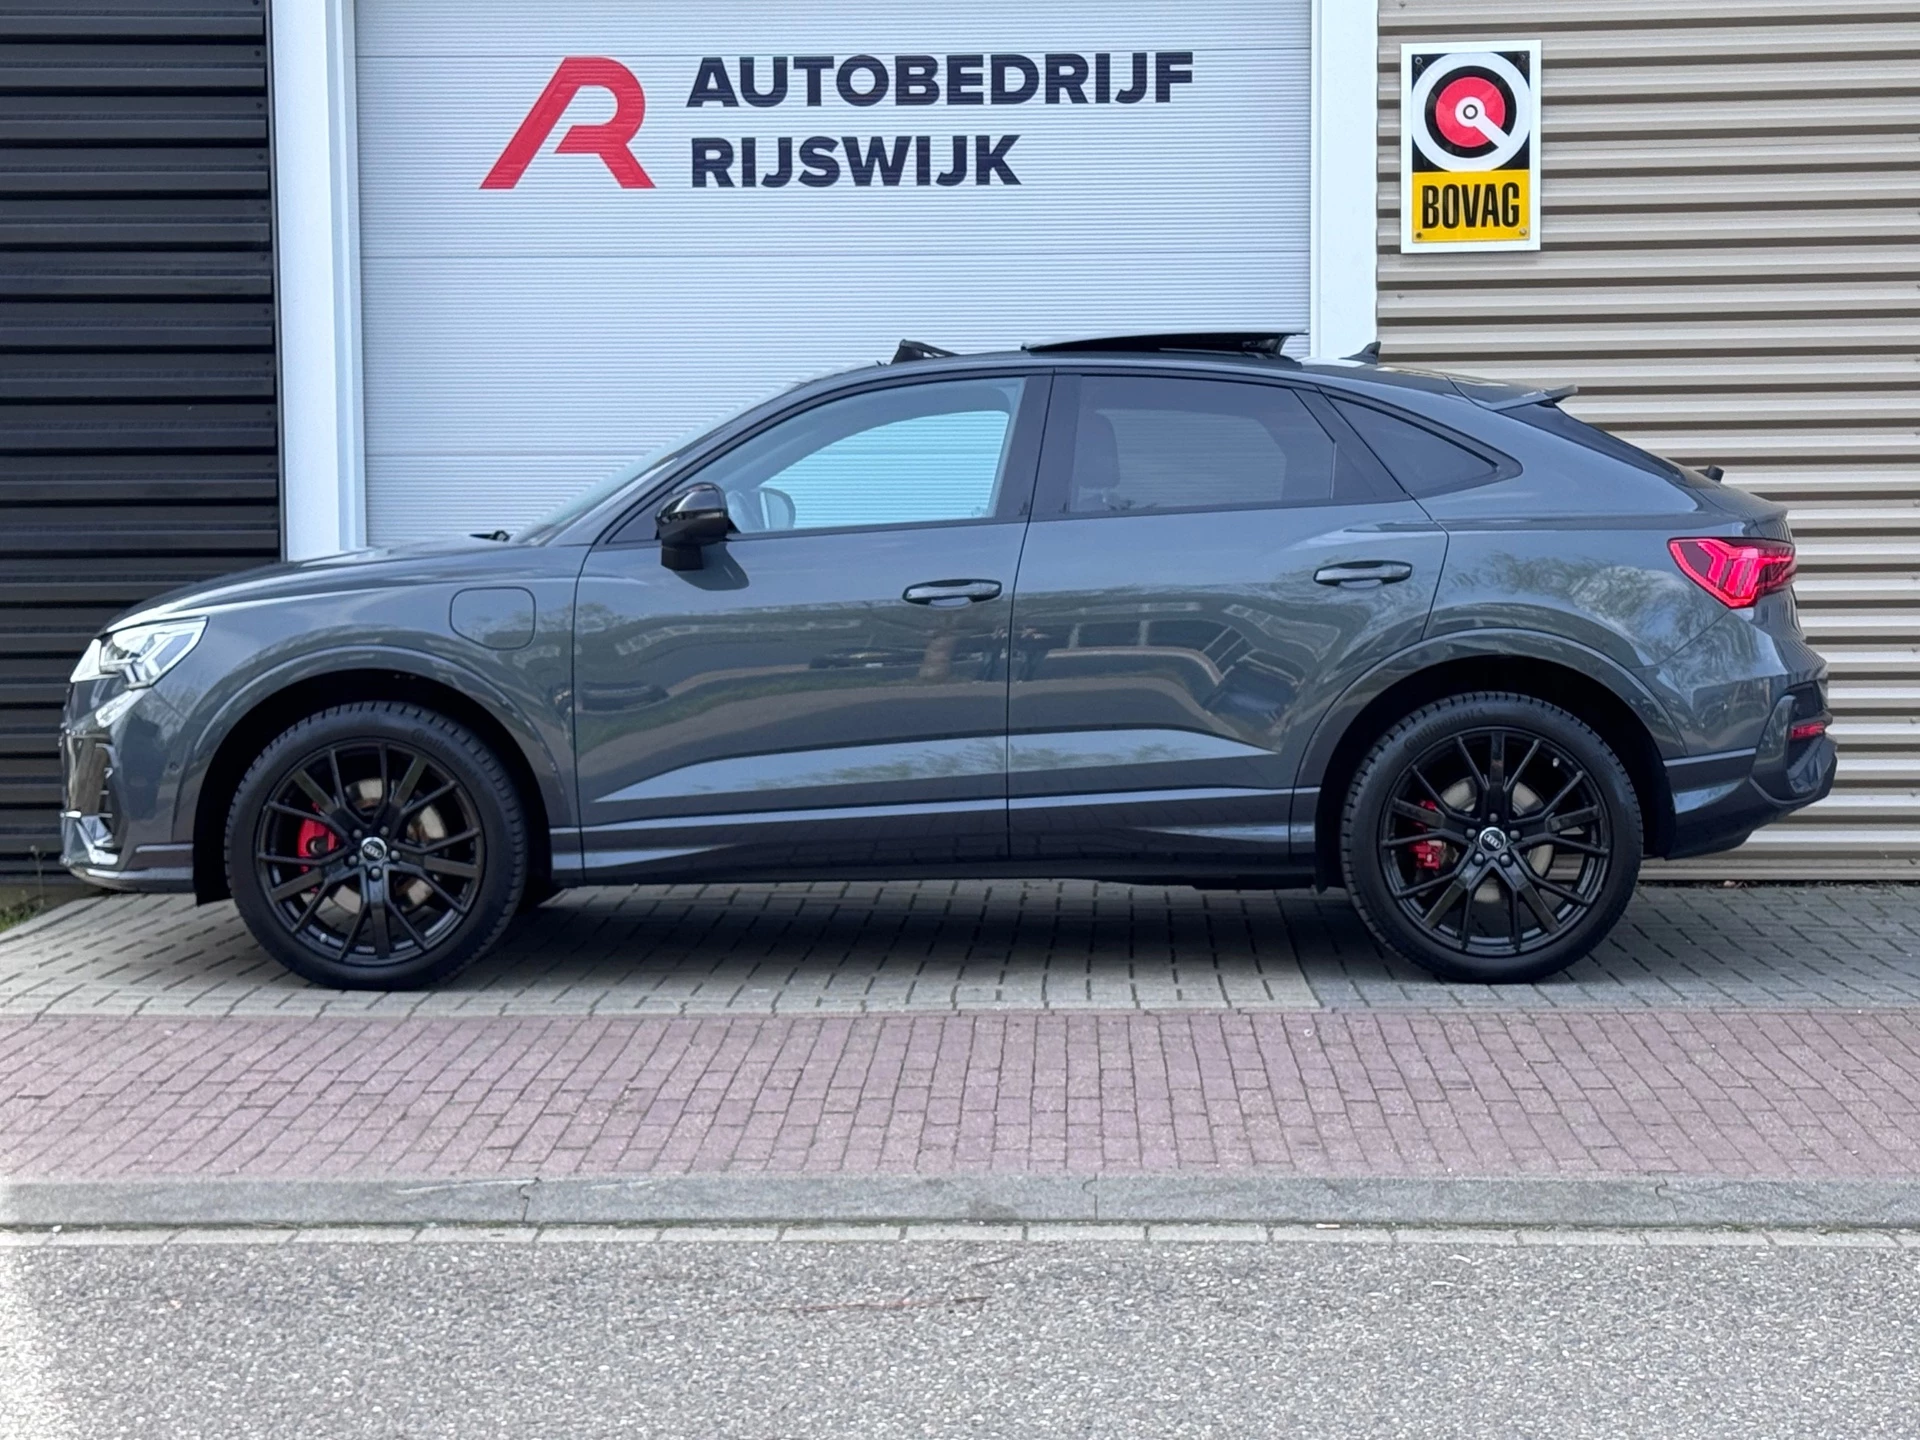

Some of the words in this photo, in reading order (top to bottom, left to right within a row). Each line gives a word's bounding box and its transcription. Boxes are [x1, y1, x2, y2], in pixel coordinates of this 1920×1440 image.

[686, 51, 1194, 108] AUTOBEDRIJF
[691, 134, 1022, 188] RIJSWIJK
[1422, 182, 1520, 229] BOVAG
